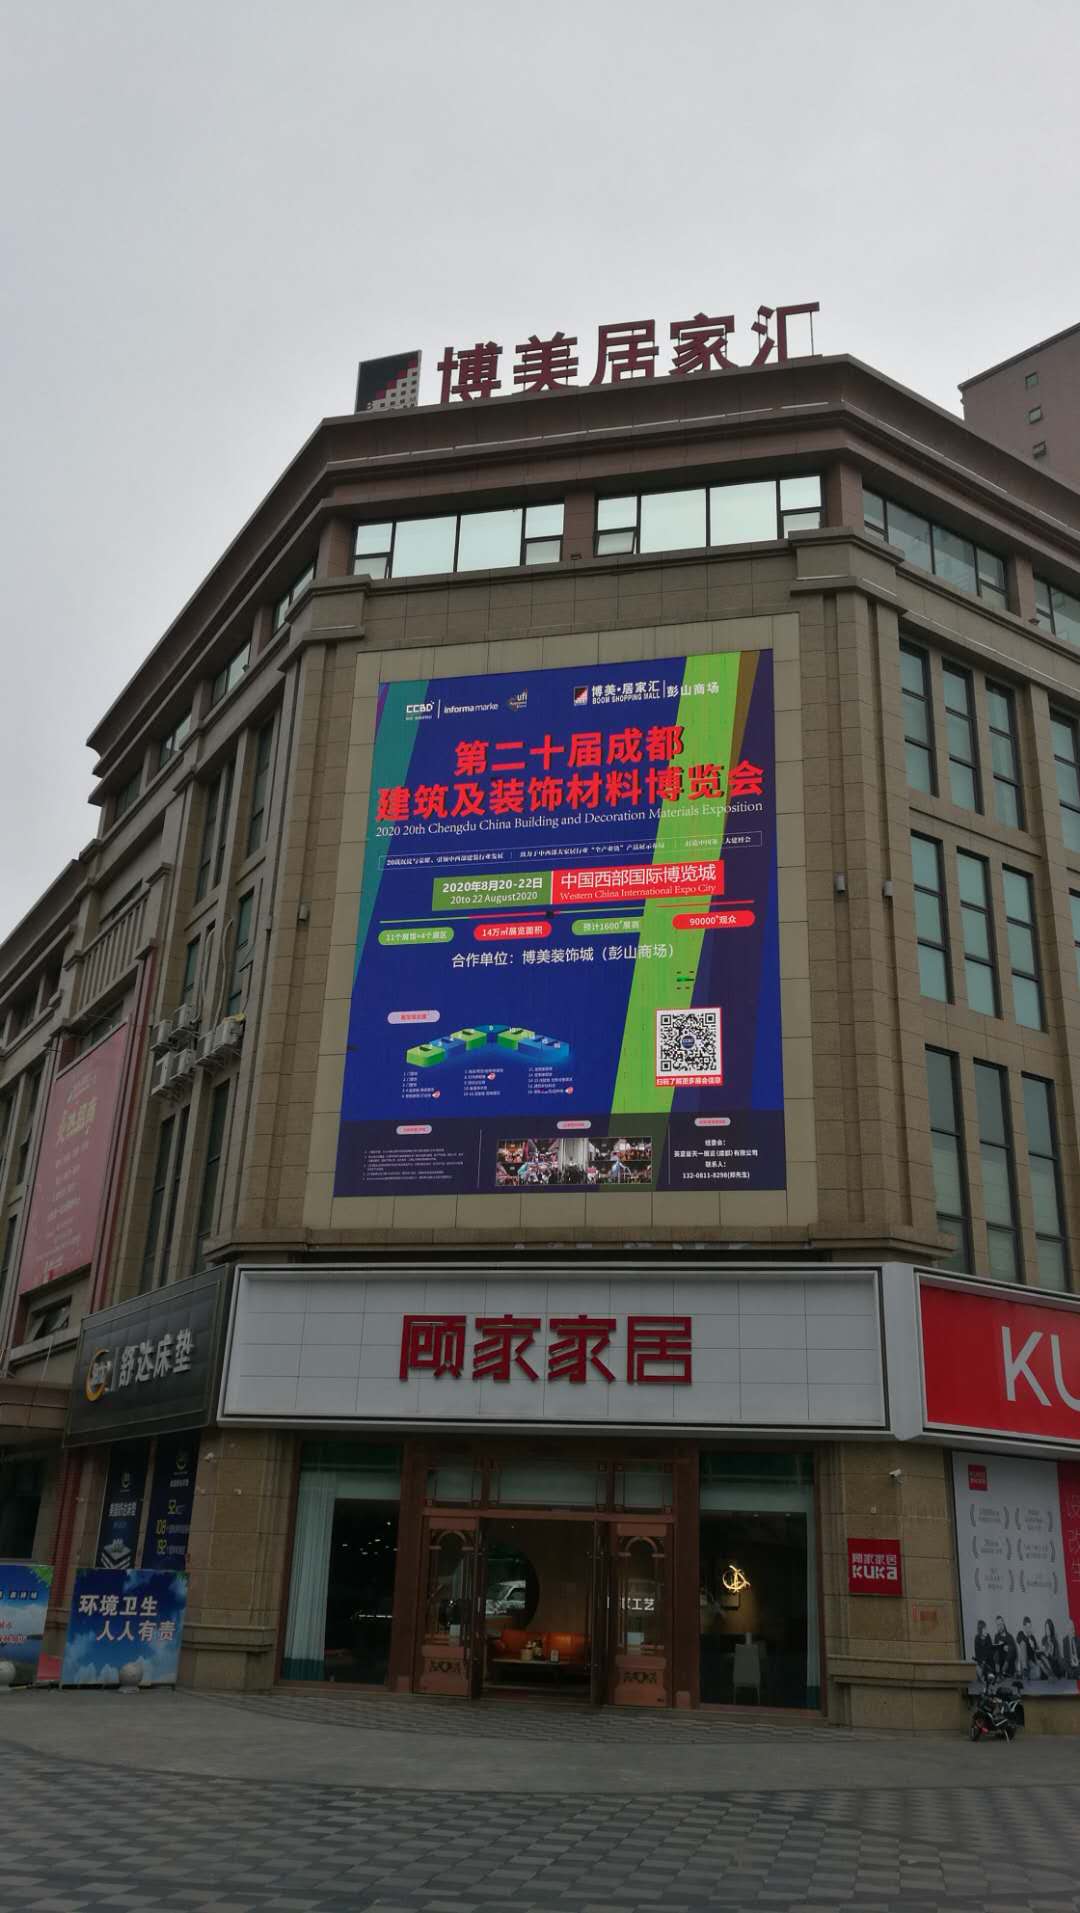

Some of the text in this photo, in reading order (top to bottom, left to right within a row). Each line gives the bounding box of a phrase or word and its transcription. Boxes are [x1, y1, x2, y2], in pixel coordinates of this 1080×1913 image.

[437, 301, 820, 405] 博美居家汇
[612, 694, 642, 703] SHOPPING
[667, 681, 720, 697] 彭山商场
[454, 725, 685, 777] 第二十届成都
[375, 759, 765, 822] 建筑及装饰材料博览会
[376, 802, 763, 837] 2020 20th Chengdu China Building and Decoration Materials Exposition
[442, 863, 717, 893] 2020年8月20-22日 中国西部国际博览城
[560, 883, 717, 900] Western China International Expo City
[472, 894, 484, 904] 22
[118, 1328, 195, 1387] 舒达床垫
[399, 1314, 692, 1385] 顾家家居
[78, 1594, 159, 1617] 环境卫生
[96, 1620, 177, 1642] 人人有责
